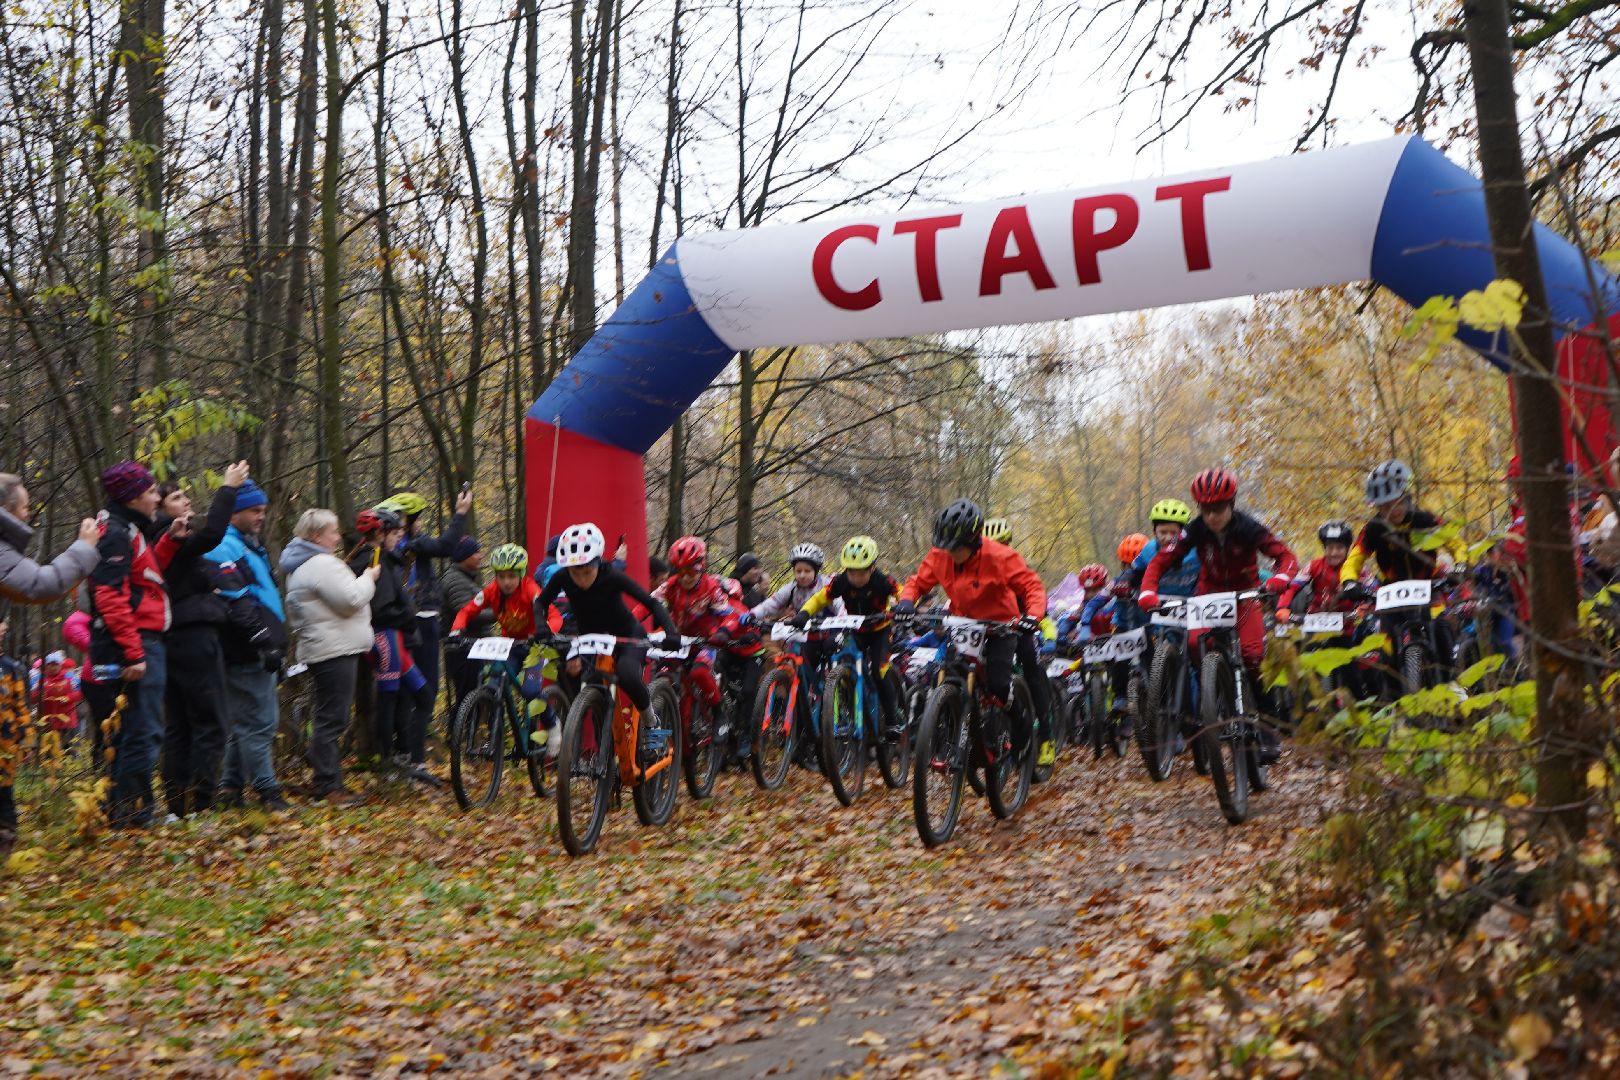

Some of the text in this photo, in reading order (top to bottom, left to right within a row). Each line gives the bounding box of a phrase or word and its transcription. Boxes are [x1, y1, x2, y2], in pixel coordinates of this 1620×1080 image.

[812, 175, 1231, 311] СТАРТ
[1380, 587, 1427, 601] 105
[1190, 602, 1235, 621] 122
